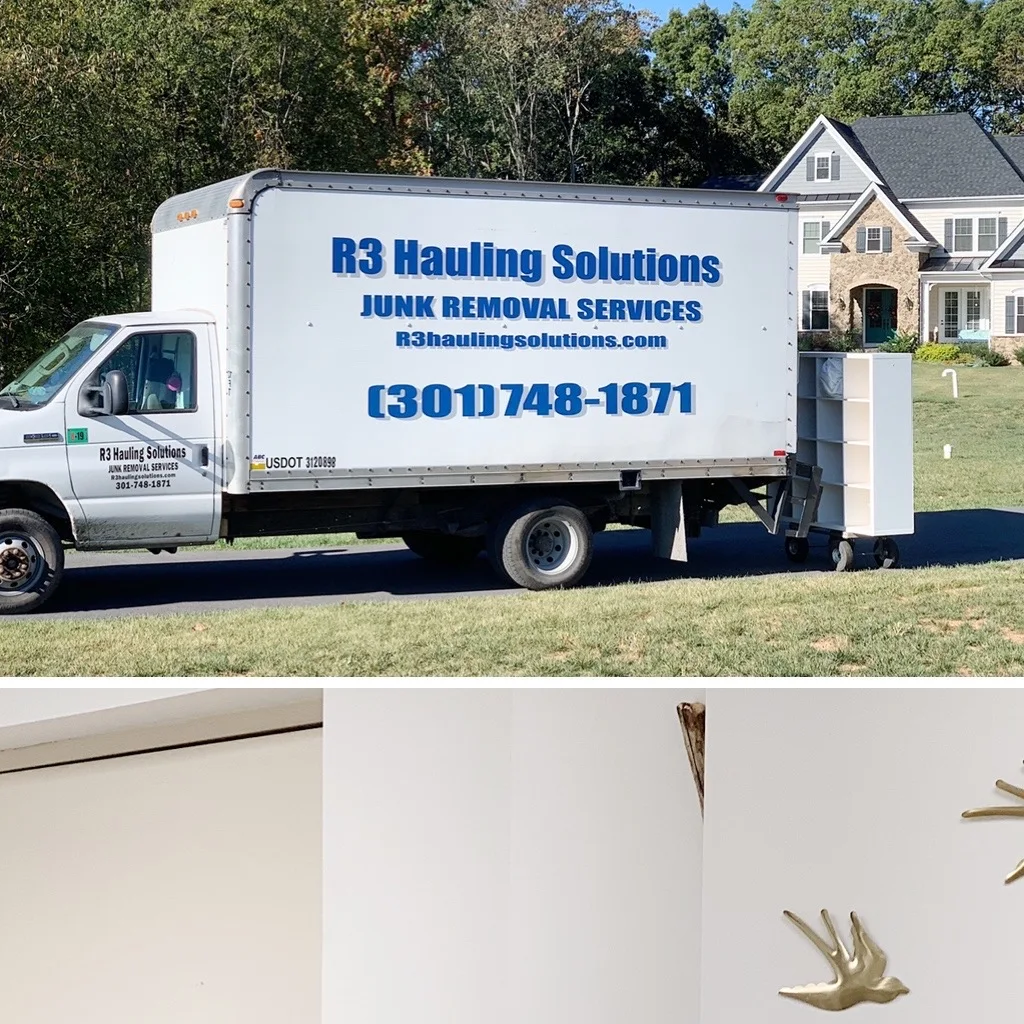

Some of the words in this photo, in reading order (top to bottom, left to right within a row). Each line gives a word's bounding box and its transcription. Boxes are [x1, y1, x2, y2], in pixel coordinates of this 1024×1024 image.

[332, 237, 384, 276] R3
[394, 239, 545, 284] Hauling
[552, 244, 721, 285] Solutions
[360, 294, 436, 319] JUNK
[443, 296, 571, 321] REMOVAL
[577, 298, 703, 322] SERVICES
[395, 331, 668, 349] R3haulingsolutions.com
[367, 381, 695, 419] (301)748-1871
[99, 447, 111, 461] R3
[113, 446, 145, 462] Hauling
[146, 445, 187, 460] Solutions
[108, 464, 122, 474] JUNK
[123, 463, 150, 473] REMOVAL
[151, 462, 179, 472] SERVICES
[265, 456, 303, 469] USDOT
[115, 480, 171, 490] 301-748-1871
